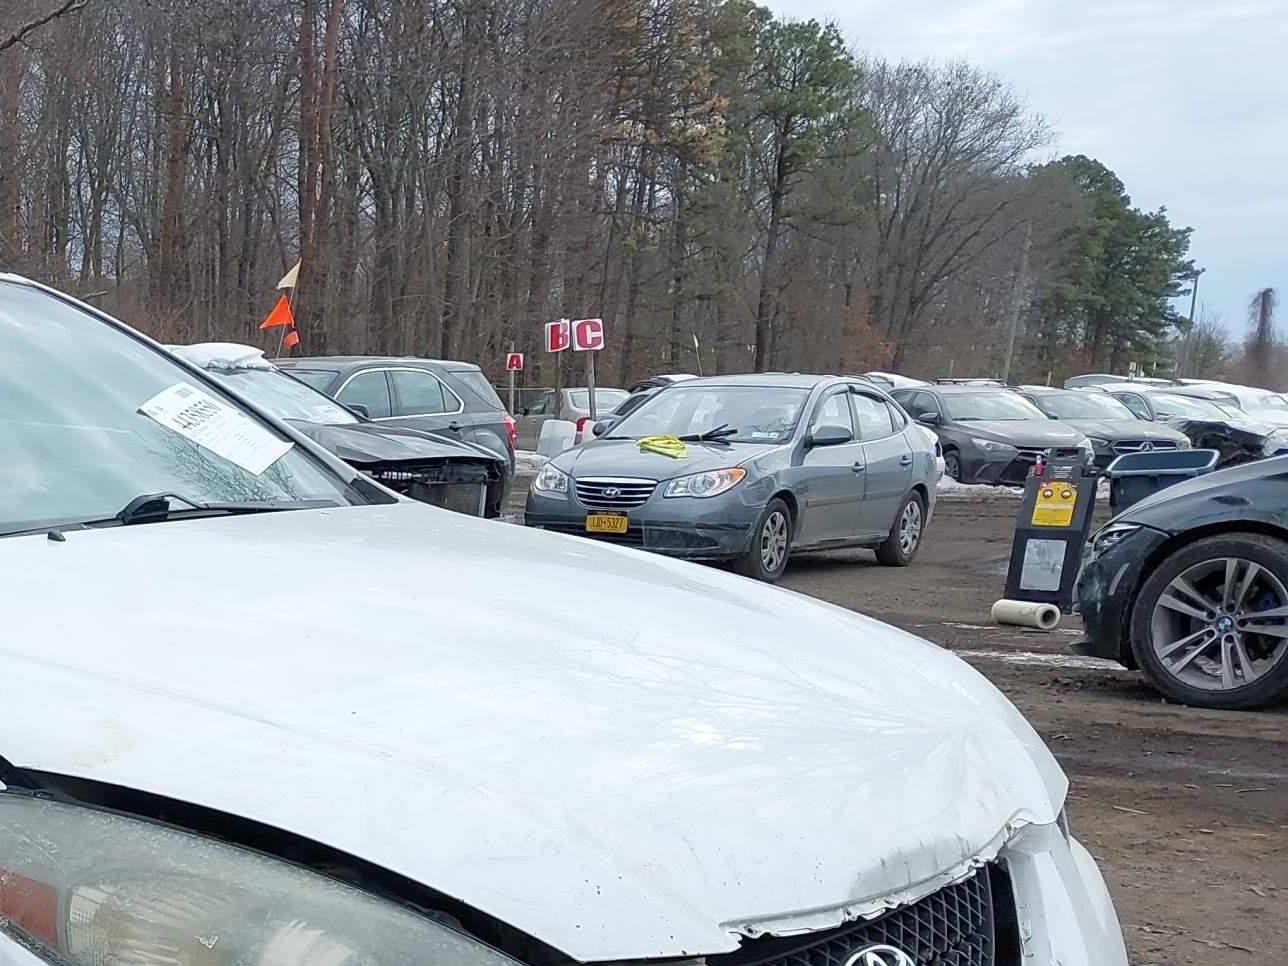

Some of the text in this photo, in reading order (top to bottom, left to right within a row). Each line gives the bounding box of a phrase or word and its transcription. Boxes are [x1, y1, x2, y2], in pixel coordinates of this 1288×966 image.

[549, 323, 569, 350] B
[576, 321, 602, 348] C
[508, 354, 522, 369] A
